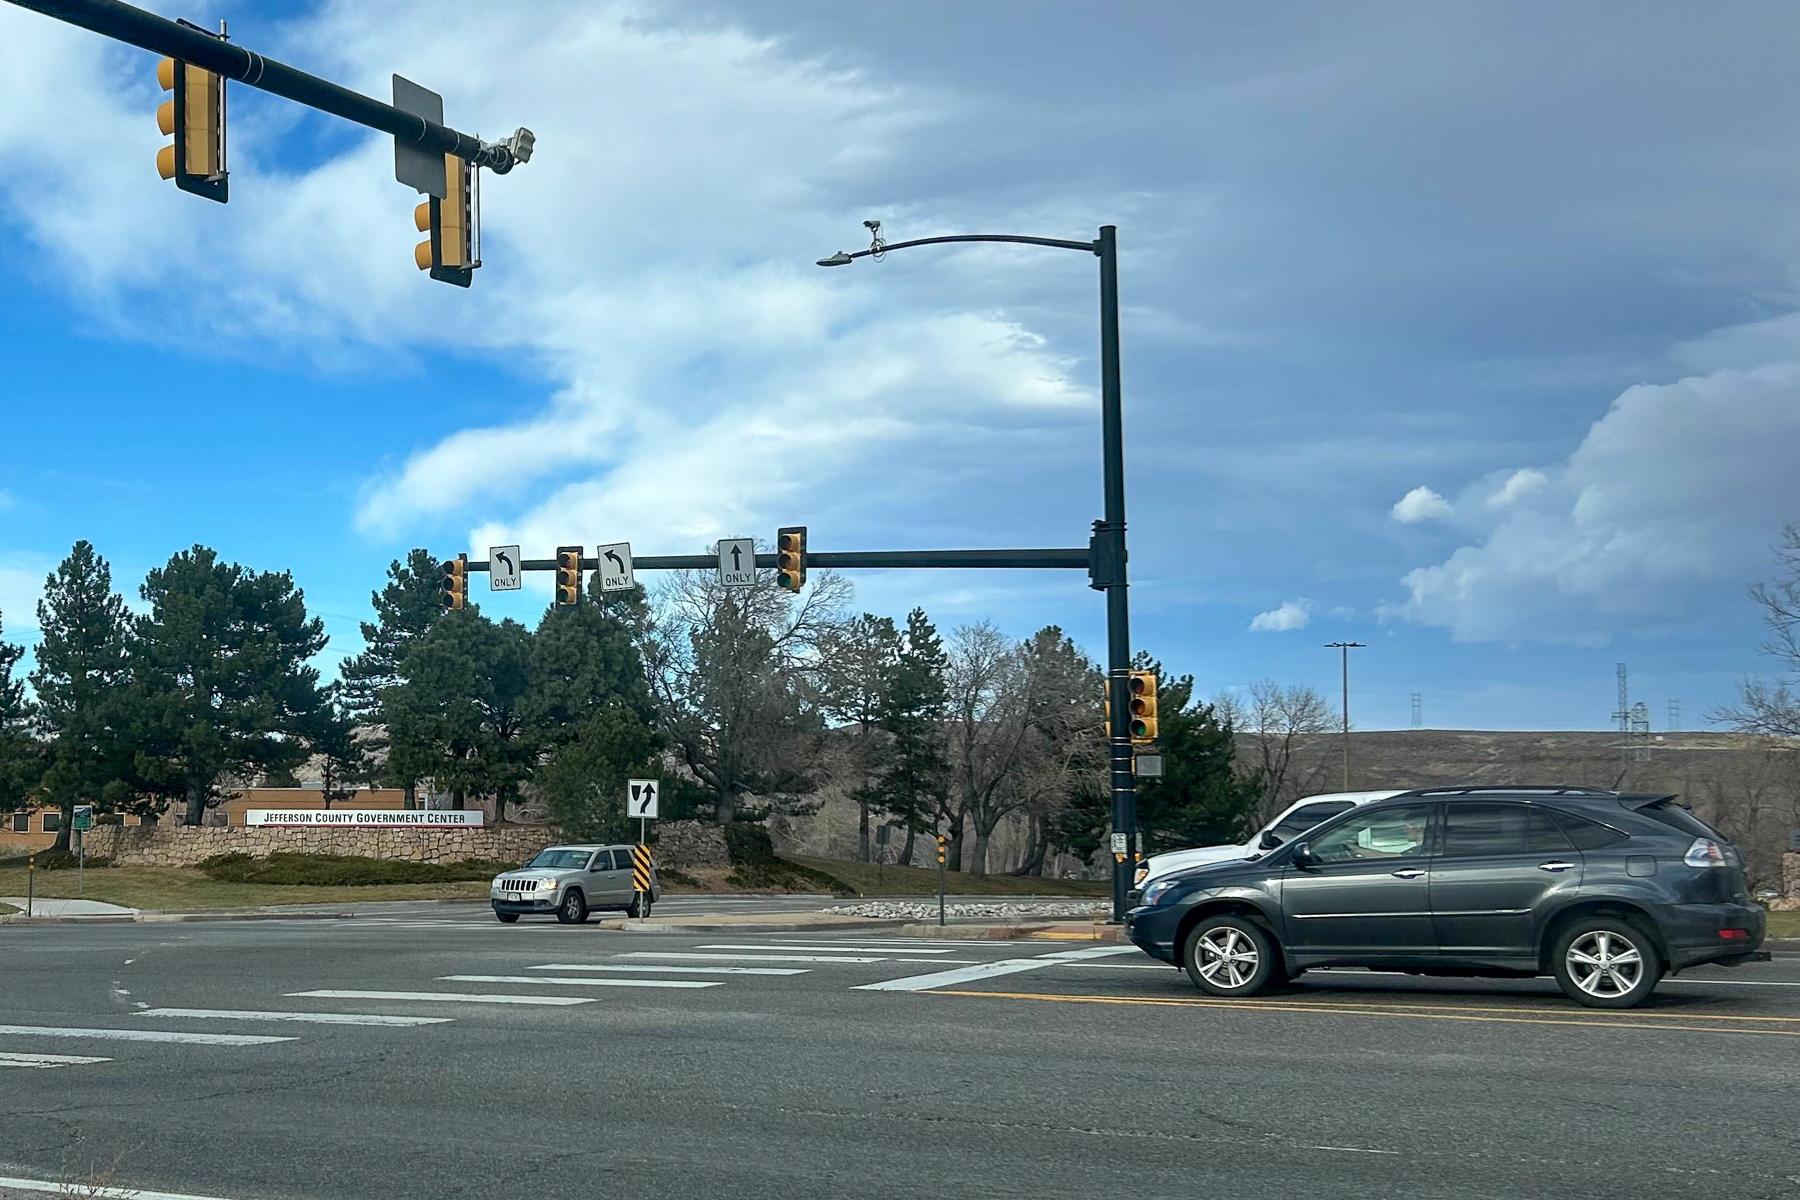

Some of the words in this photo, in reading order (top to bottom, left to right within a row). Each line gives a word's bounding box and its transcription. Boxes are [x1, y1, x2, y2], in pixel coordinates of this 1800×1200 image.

[494, 577, 517, 587] ONLY
[605, 576, 629, 587] ONLY
[725, 572, 749, 584] ONLY
[263, 812, 313, 823] JEFFERSON
[315, 812, 354, 824] COUNTY
[356, 812, 424, 824] GOVERNMENT
[427, 813, 466, 824] CENTER
